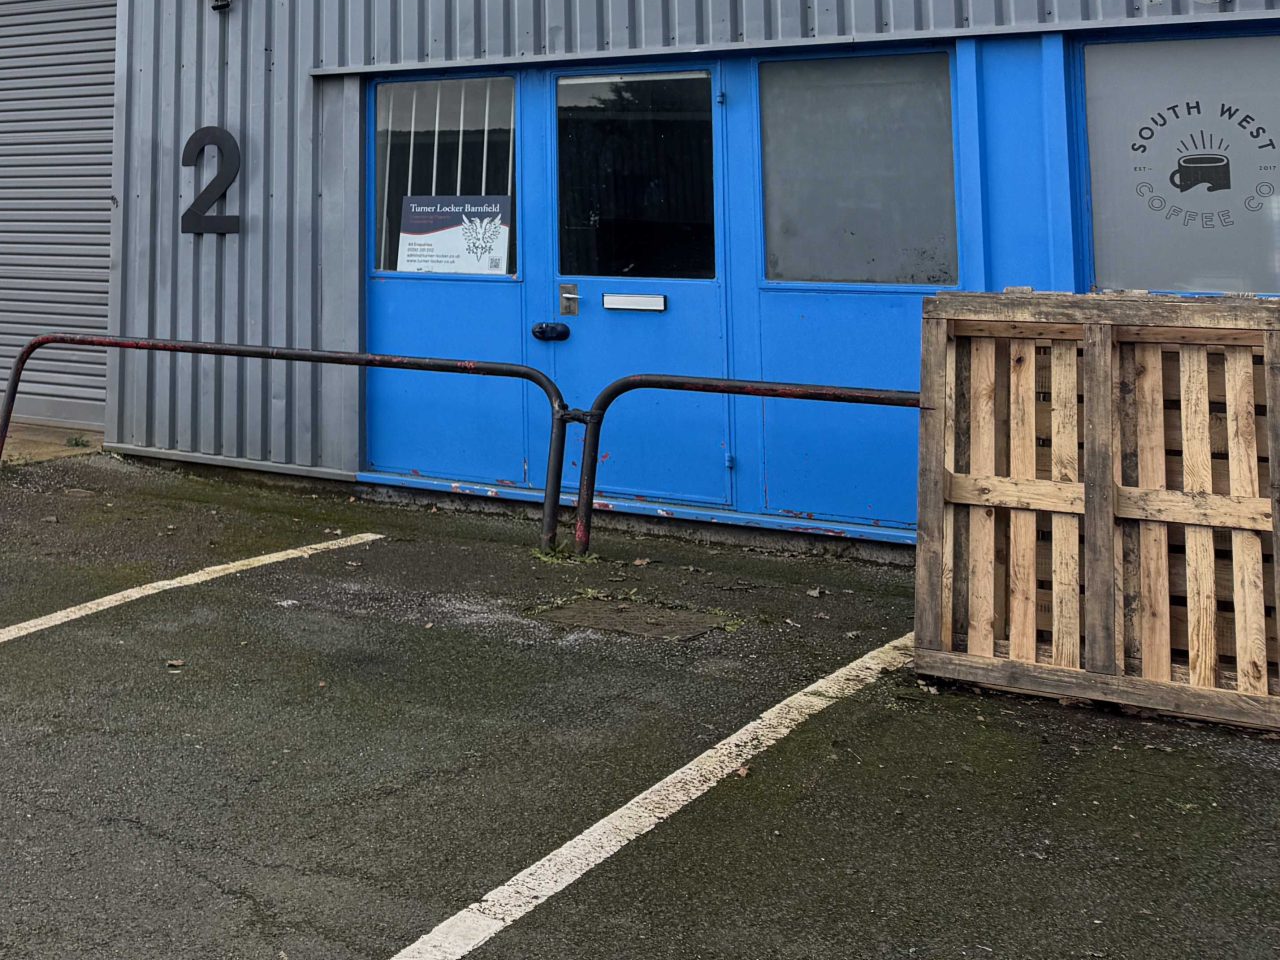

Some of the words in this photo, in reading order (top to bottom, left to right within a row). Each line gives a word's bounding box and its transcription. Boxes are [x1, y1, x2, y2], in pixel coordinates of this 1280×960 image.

[1131, 100, 1202, 154] SOUTH
[1219, 103, 1277, 151] WEST
[181, 126, 240, 234] 2
[1135, 181, 1235, 229] COFFEE
[1244, 181, 1275, 212] CO
[410, 203, 435, 213] Turner
[436, 203, 463, 213] Locker
[464, 203, 500, 213] Barnfield
